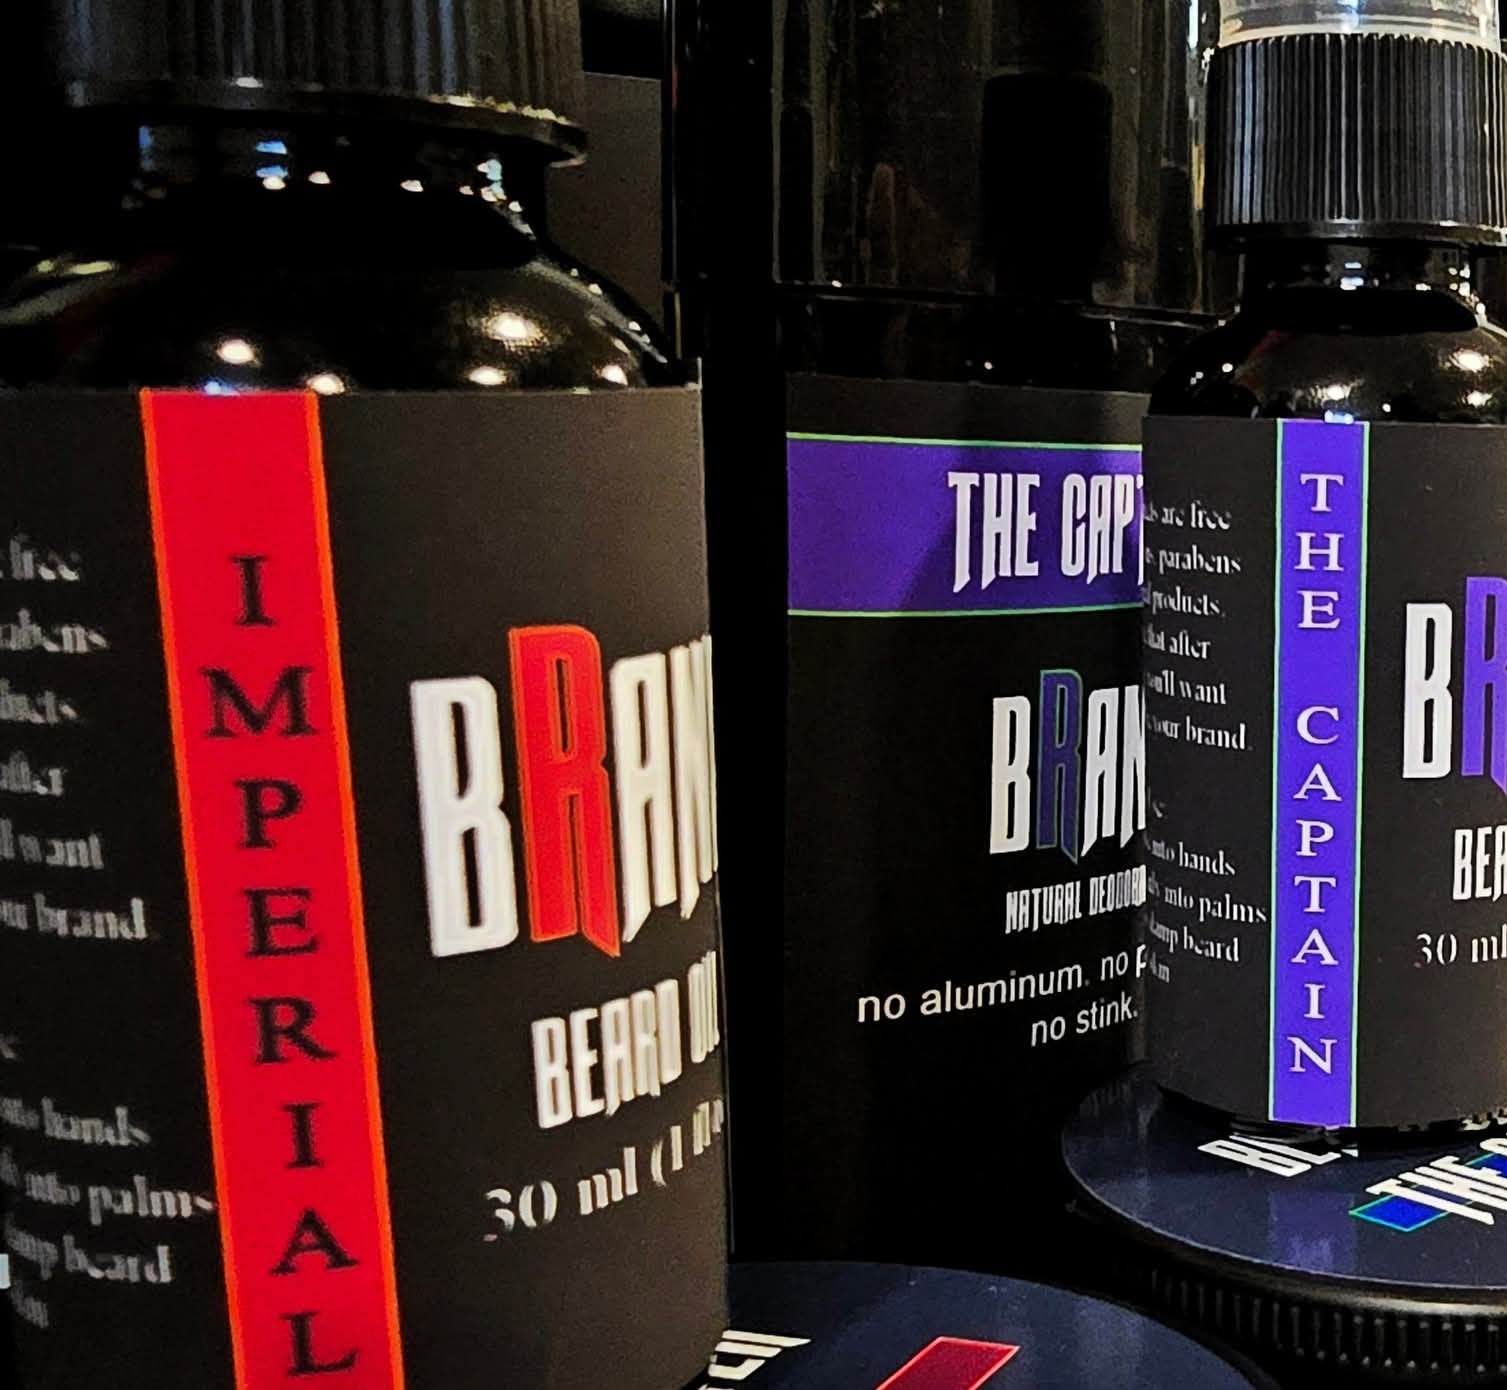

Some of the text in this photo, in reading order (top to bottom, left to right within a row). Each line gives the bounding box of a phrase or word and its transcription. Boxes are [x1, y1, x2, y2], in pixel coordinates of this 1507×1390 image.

[947, 471, 1041, 593] THE
[1286, 472, 1345, 1076] THE CAPTAIN
[1178, 840, 1237, 877] hands
[1005, 880, 1083, 935] NATURAL
[1199, 892, 1268, 924] palms
[199, 554, 360, 1377] IMPERIAL
[1413, 933, 1457, 969] 30
[1471, 922, 1507, 974] ml
[857, 993, 907, 1023] no
[1100, 950, 1129, 987] no
[1031, 990, 1139, 1047] no stink.
[531, 978, 682, 1130] BEARD
[576, 1145, 639, 1216] ml
